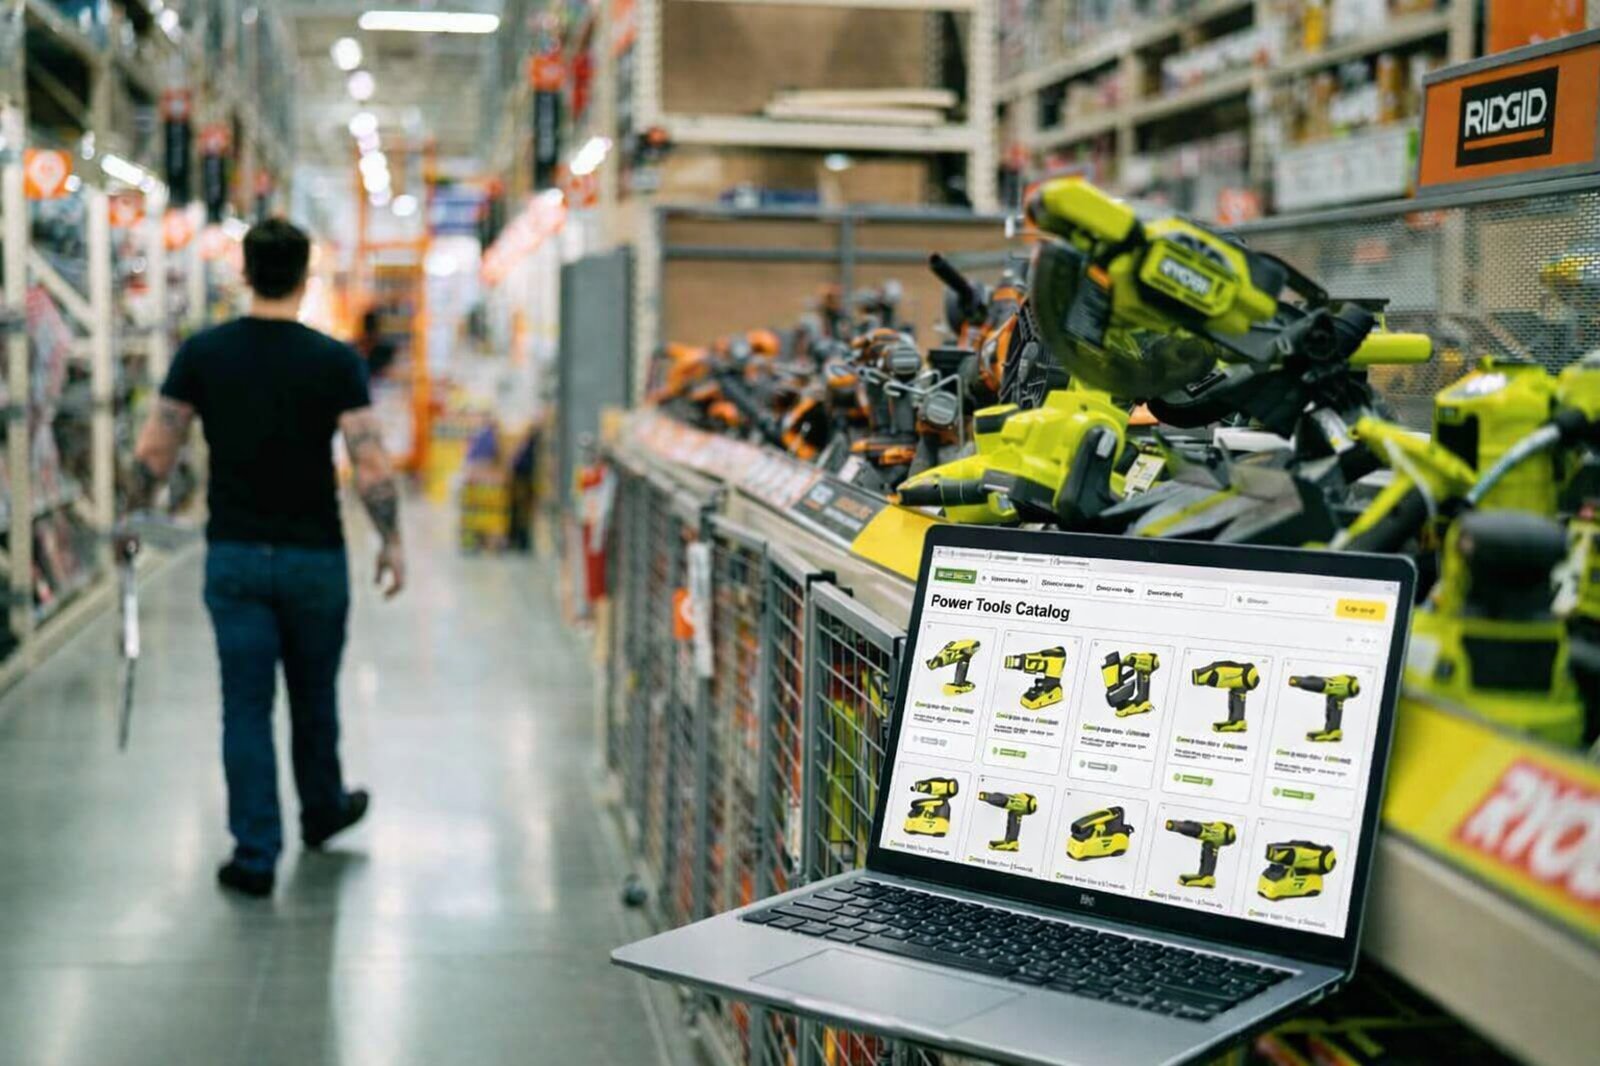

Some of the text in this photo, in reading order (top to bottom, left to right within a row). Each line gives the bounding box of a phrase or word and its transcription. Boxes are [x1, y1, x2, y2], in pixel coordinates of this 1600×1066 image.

[1464, 87, 1547, 137] RIDGID
[931, 594, 1070, 622] Power Tools Catalog
